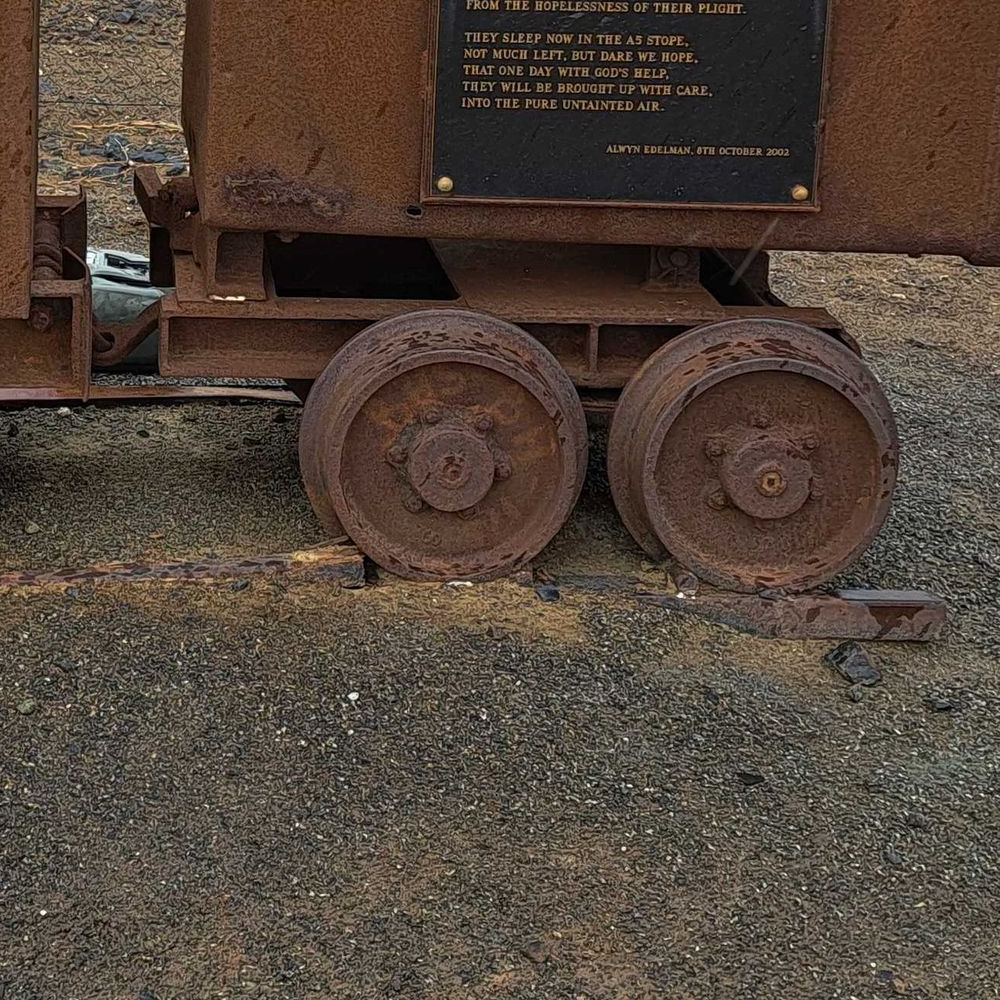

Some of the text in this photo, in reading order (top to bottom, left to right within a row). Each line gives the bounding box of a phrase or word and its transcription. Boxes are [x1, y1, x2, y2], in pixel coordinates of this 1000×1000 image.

[466, 0, 500, 11] FROM
[504, 0, 530, 12] THE
[535, 0, 630, 13] HOPELESSNESS
[633, 1, 650, 13] OF
[653, 2, 693, 14] THEIR
[464, 32, 500, 44] THEY
[502, 32, 542, 45] SLEEP
[546, 33, 574, 45] NOW
[577, 33, 593, 45] IN
[595, 33, 622, 46] THE
[625, 34, 642, 46] A5
[463, 48, 489, 61] NOT
[492, 49, 528, 61] MUCH
[571, 50, 596, 62] BUT
[600, 50, 633, 62] DARE
[637, 50, 659, 63] WE
[463, 65, 495, 77] THAT
[498, 65, 525, 77] ONE
[529, 65, 555, 78] DAY
[557, 66, 590, 78] WITH
[594, 66, 630, 79] GOD'S
[462, 81, 672, 96] THEY WILL BE BROUGHT UP WITH
[461, 97, 491, 110] INTO
[494, 98, 521, 110] THE
[525, 98, 558, 111] PURE
[562, 99, 633, 111] UNTAINTED
